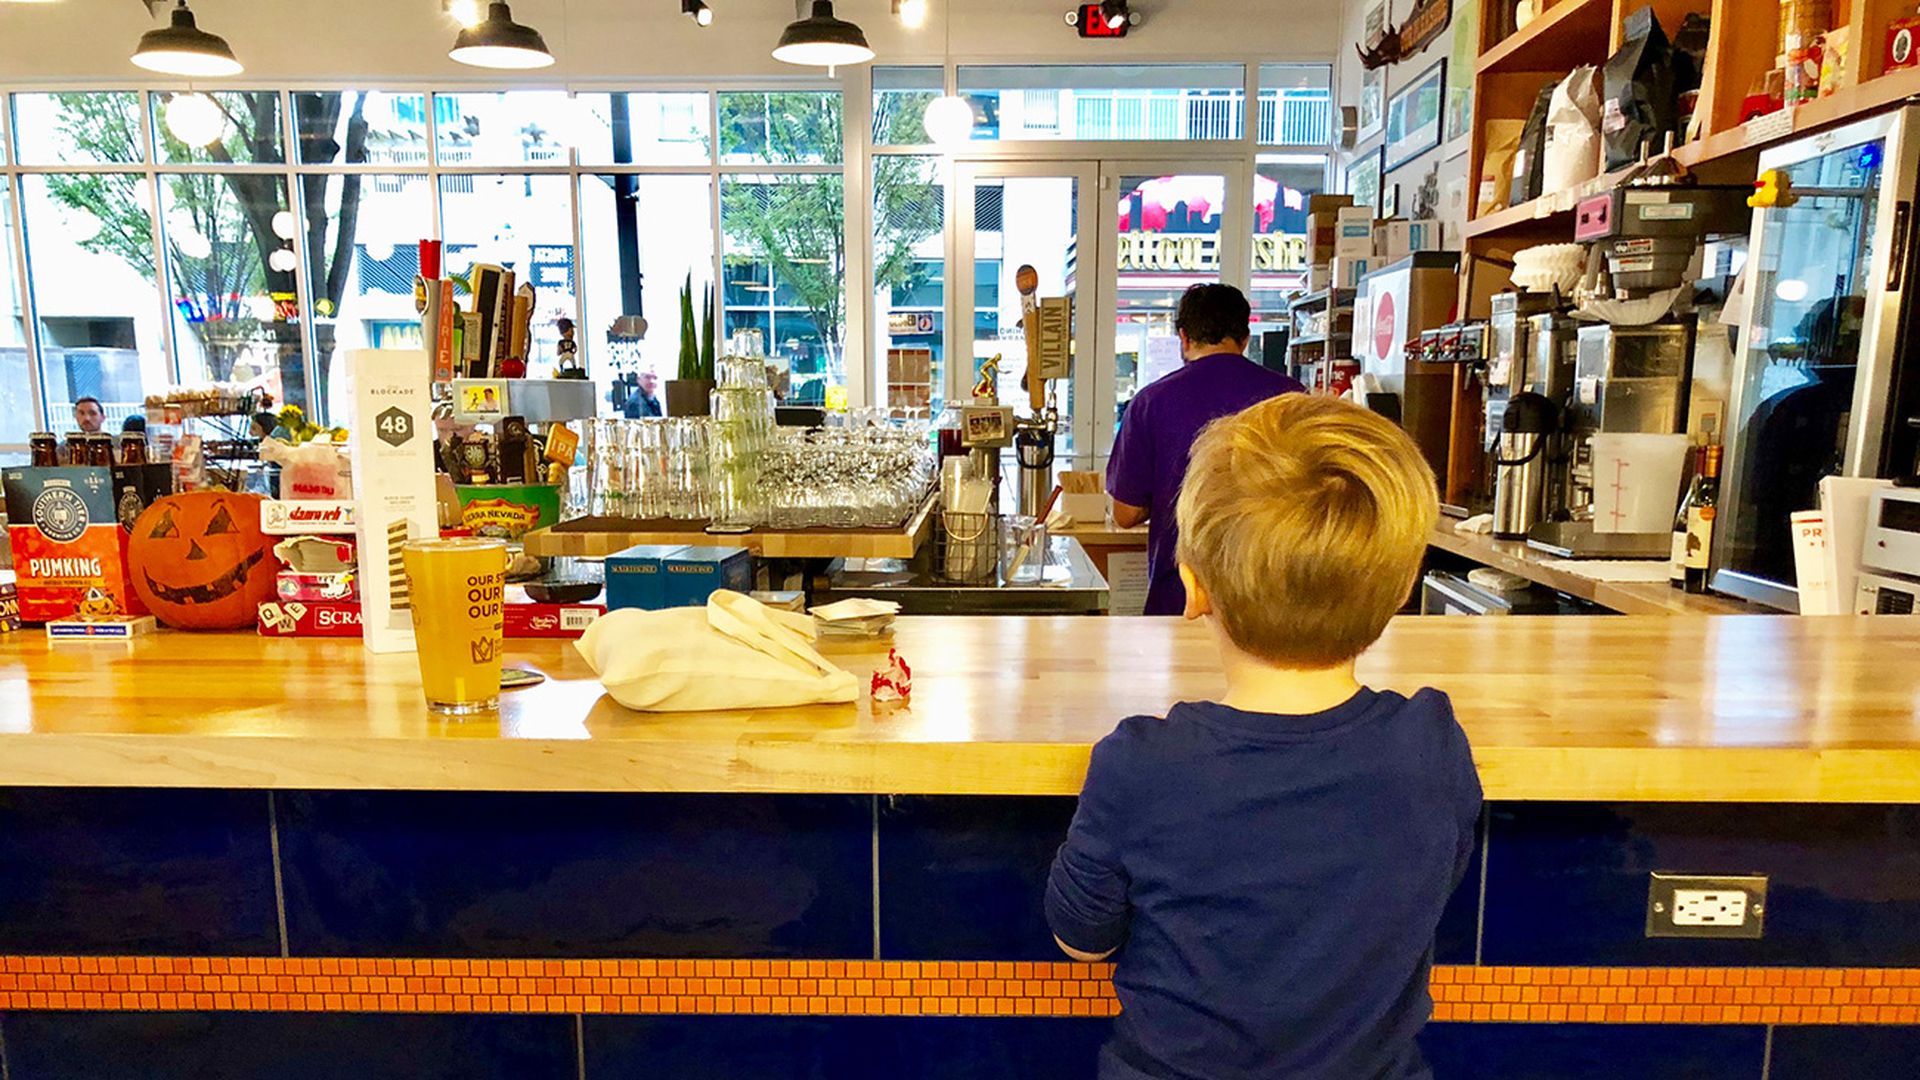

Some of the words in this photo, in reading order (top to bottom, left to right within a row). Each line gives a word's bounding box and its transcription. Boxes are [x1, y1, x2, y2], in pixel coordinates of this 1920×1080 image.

[1117, 229, 1203, 271] ellow
[1042, 306, 1063, 369] VILLAIN
[380, 416, 408, 433] 48
[551, 439, 572, 458] IPA
[35, 491, 73, 523] SOUTHERN
[488, 510, 525, 520] NEVADA
[30, 557, 102, 577] PUMKING
[467, 574, 493, 586] OUR
[467, 586, 499, 603] OUR
[468, 602, 498, 619] OUR
